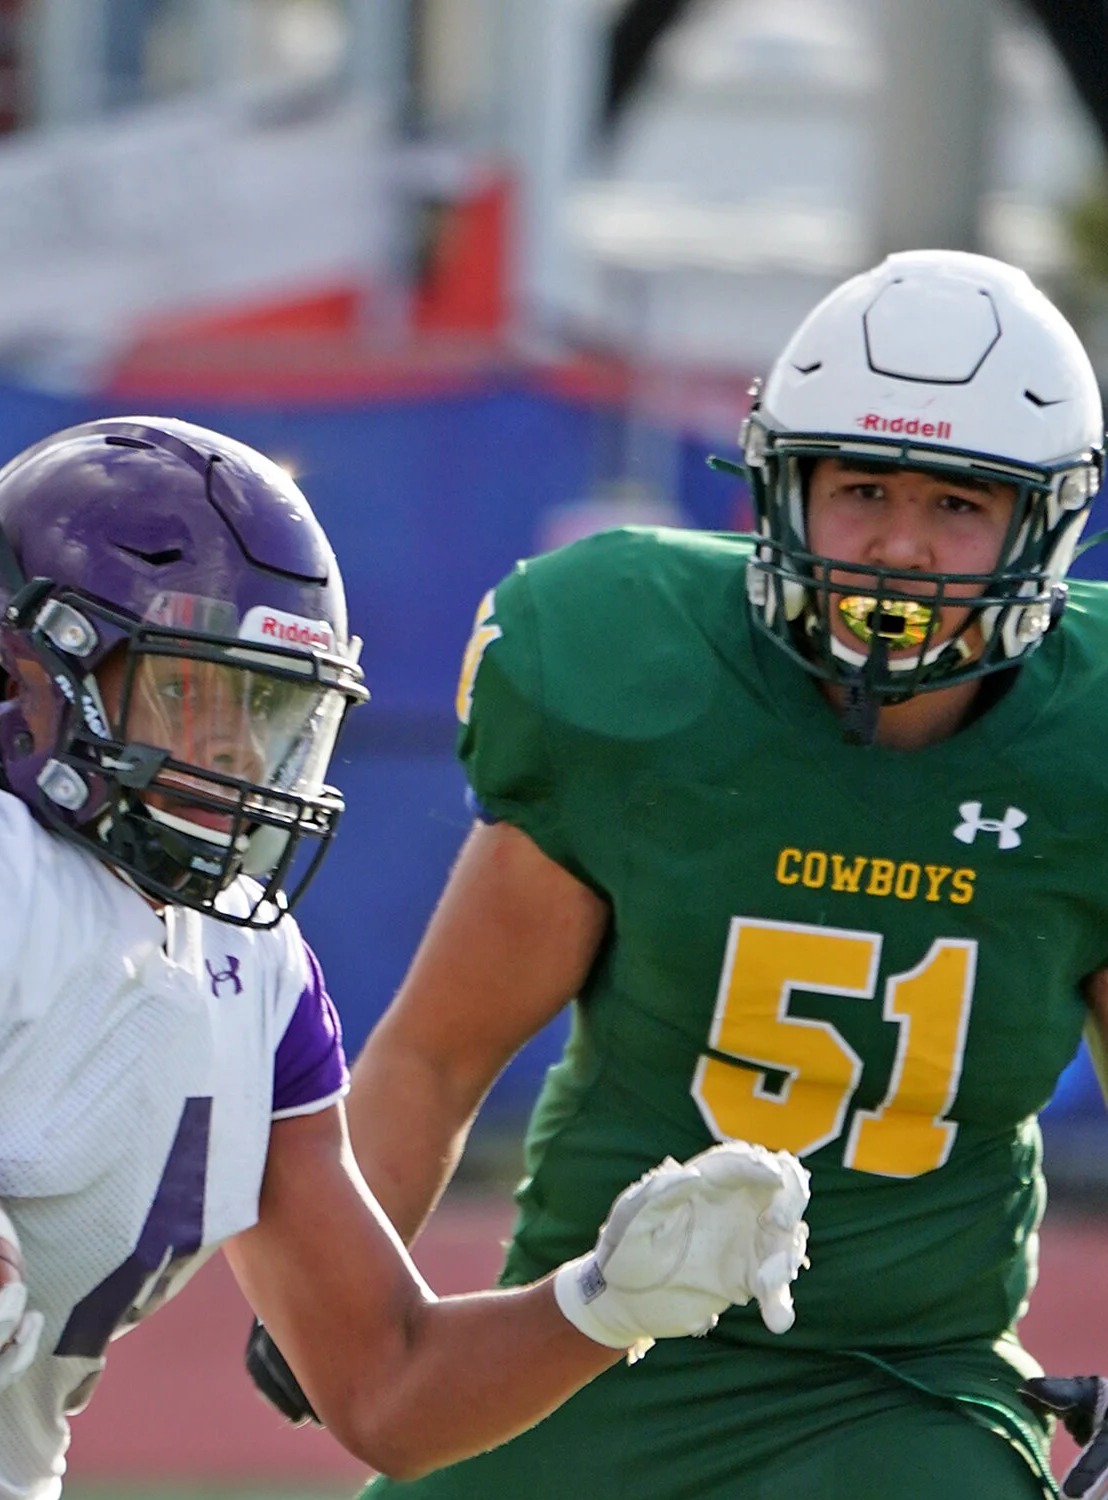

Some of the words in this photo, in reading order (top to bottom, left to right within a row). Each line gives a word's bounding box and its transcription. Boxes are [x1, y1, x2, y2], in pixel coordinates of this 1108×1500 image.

[862, 413, 951, 439] Riddell
[775, 848, 976, 905] COWBOYS
[691, 916, 978, 1179] 51
